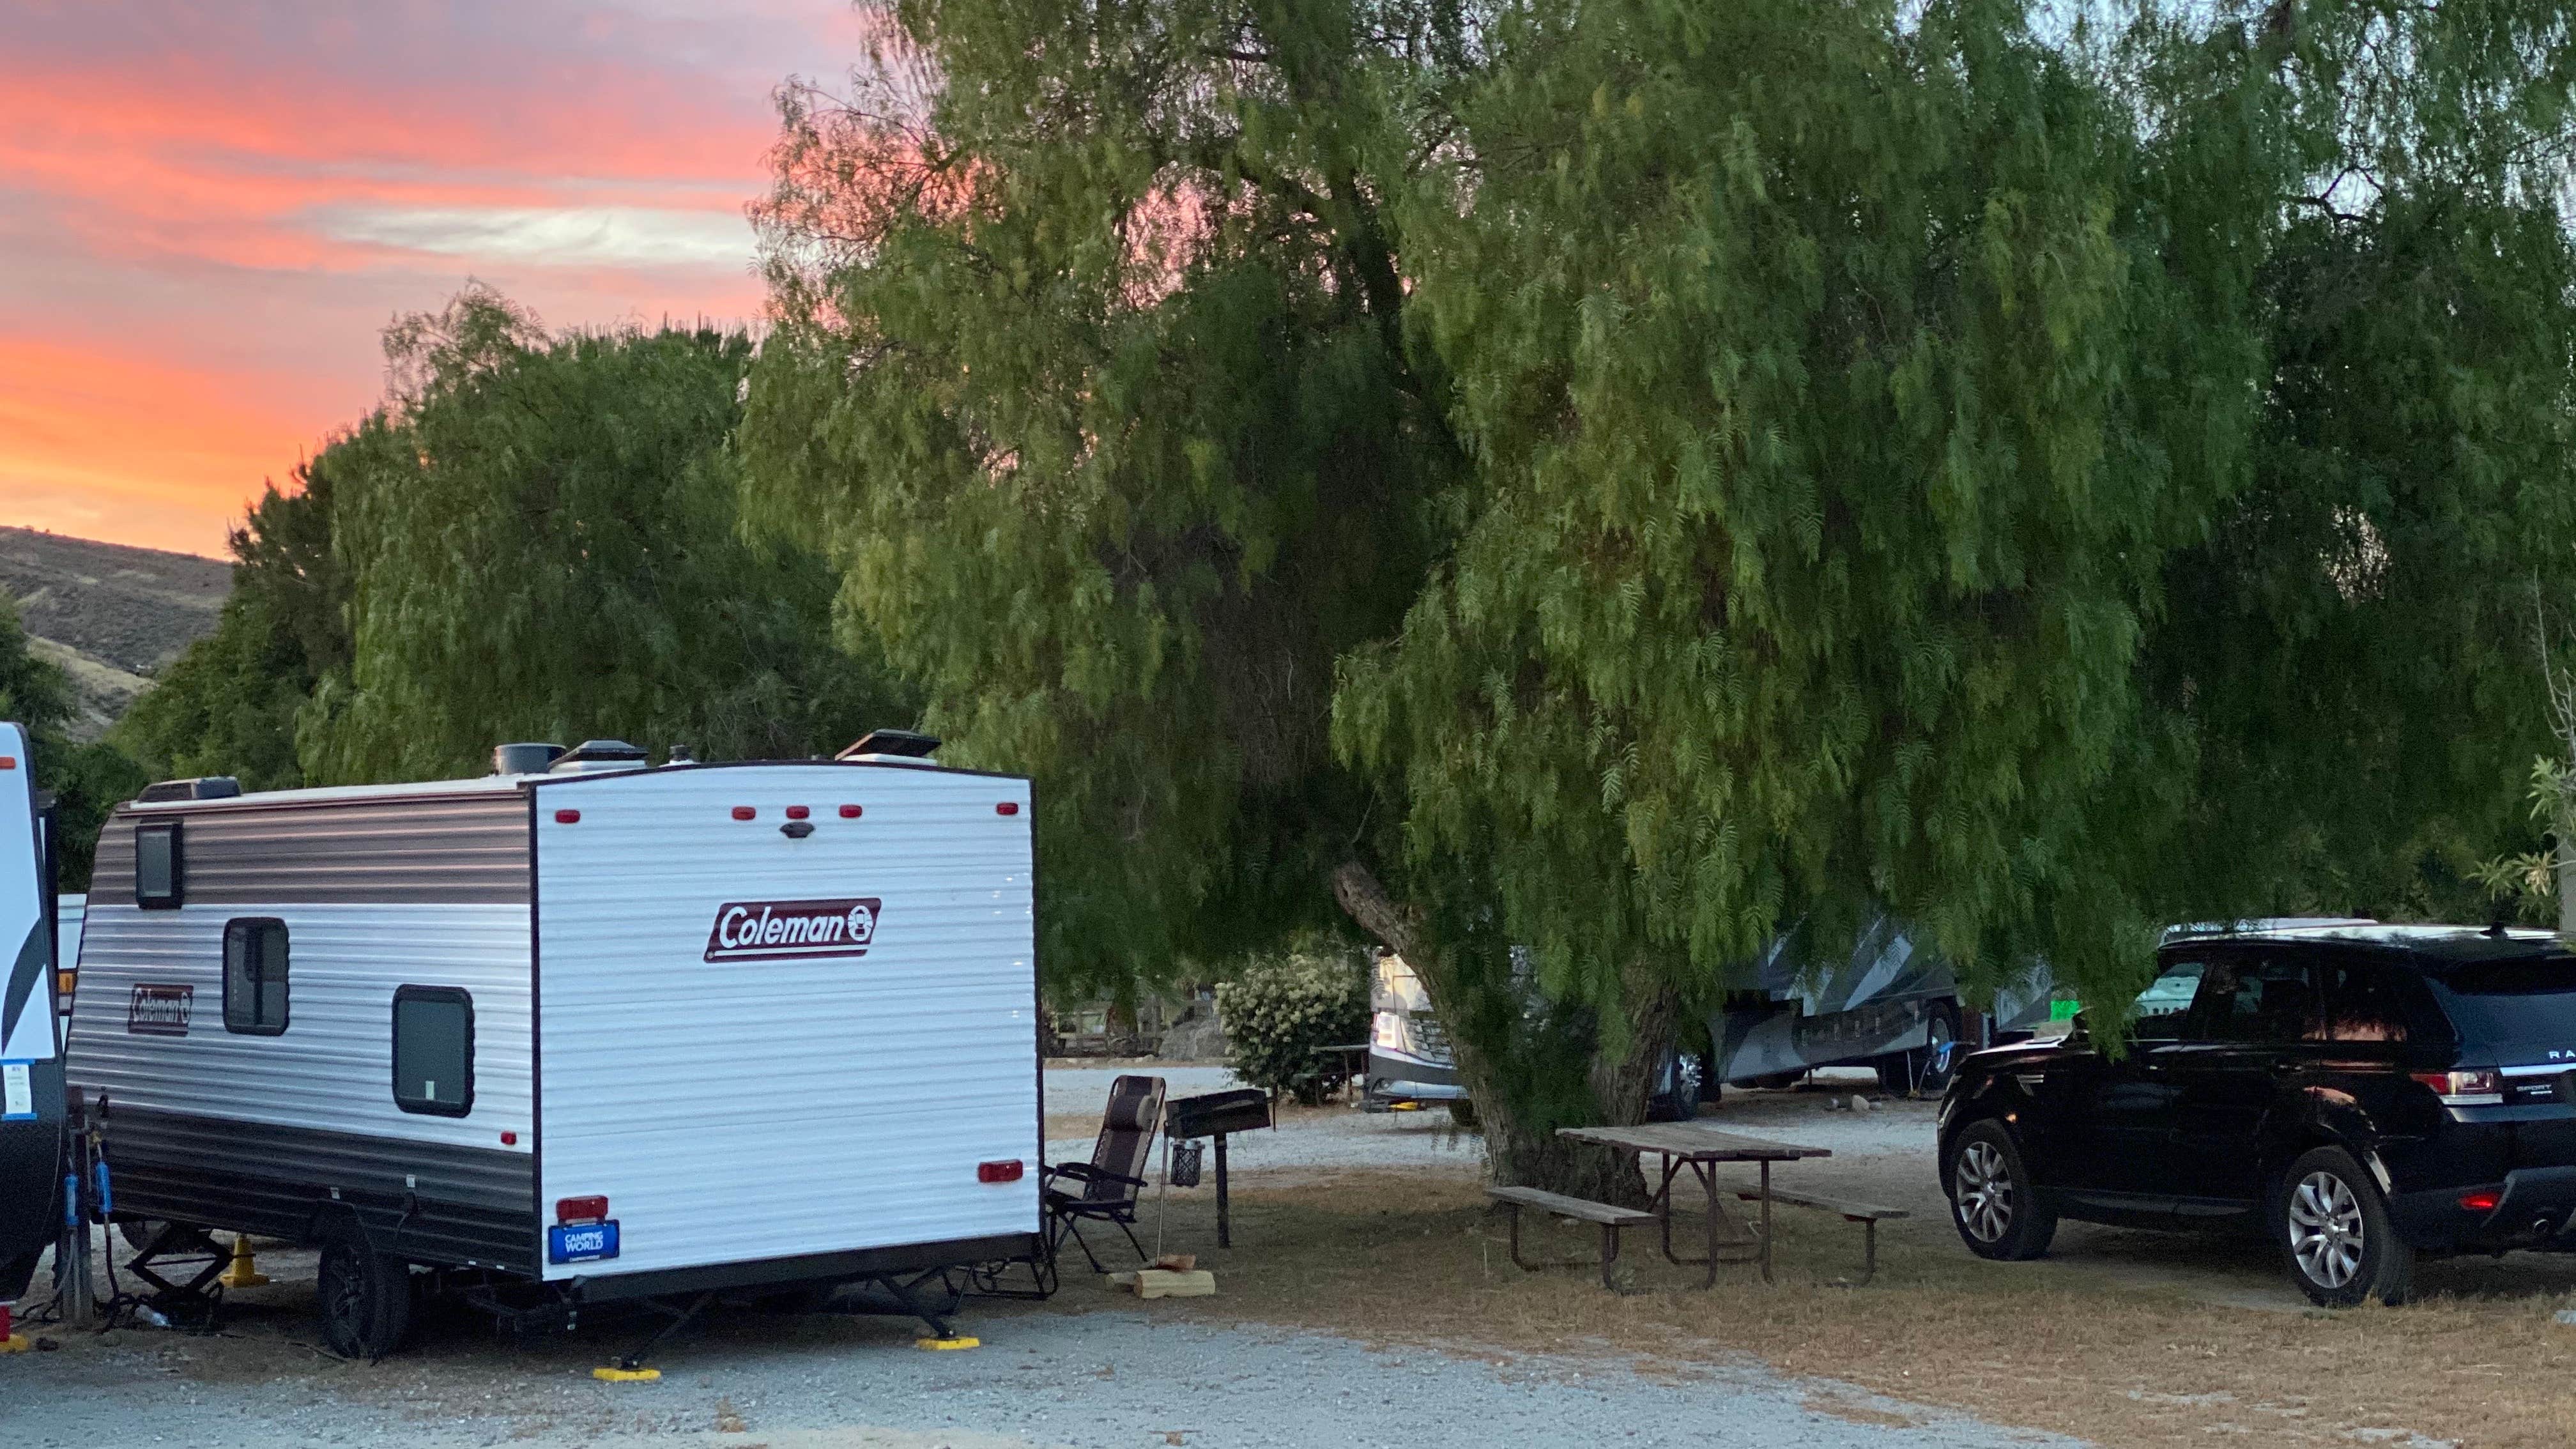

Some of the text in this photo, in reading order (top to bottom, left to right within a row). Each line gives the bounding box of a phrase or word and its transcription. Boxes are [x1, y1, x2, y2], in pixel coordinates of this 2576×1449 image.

[719, 905, 845, 949] Coleman
[132, 987, 180, 1023] Coleman
[565, 1230, 604, 1243] CAMPING
[565, 1239, 604, 1252] WORLD
